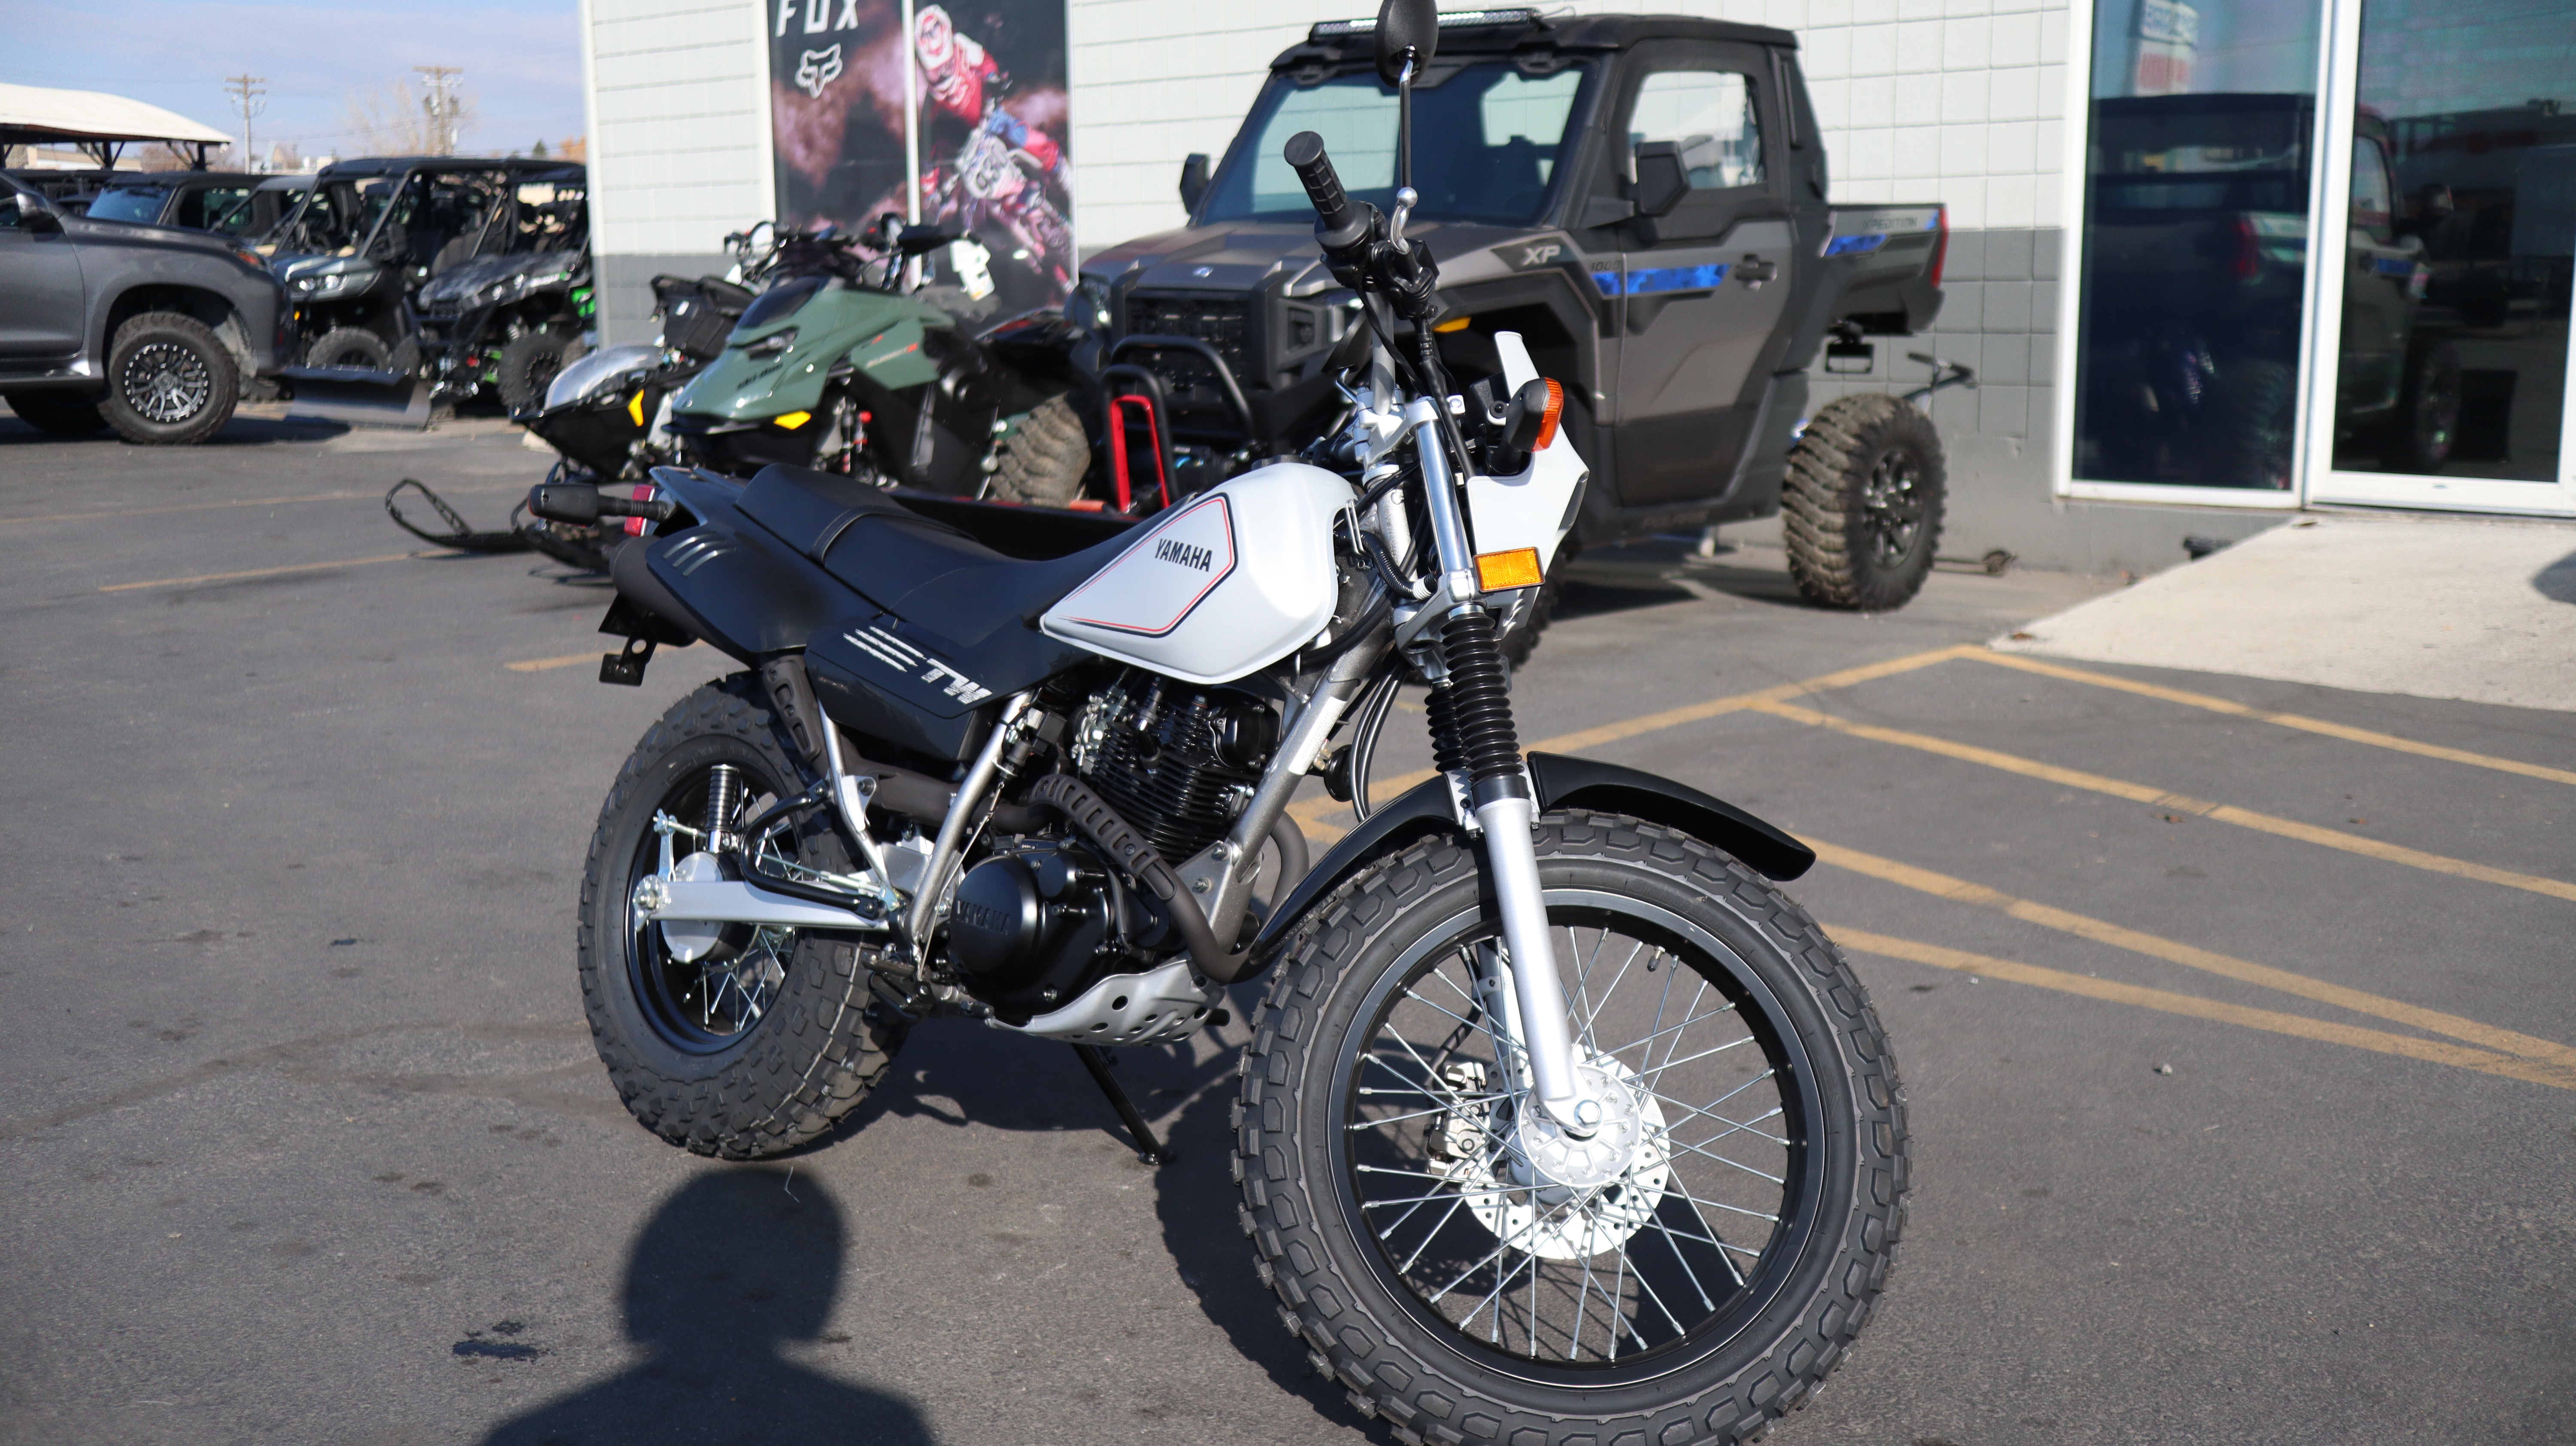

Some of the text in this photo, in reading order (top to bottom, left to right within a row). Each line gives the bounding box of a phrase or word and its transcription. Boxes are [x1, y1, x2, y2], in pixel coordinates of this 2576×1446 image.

[1523, 245, 1561, 265] XP
[1155, 538, 1212, 572] YAMAHA
[921, 658, 993, 705] TW
[957, 899, 1011, 935] YAMAHA
